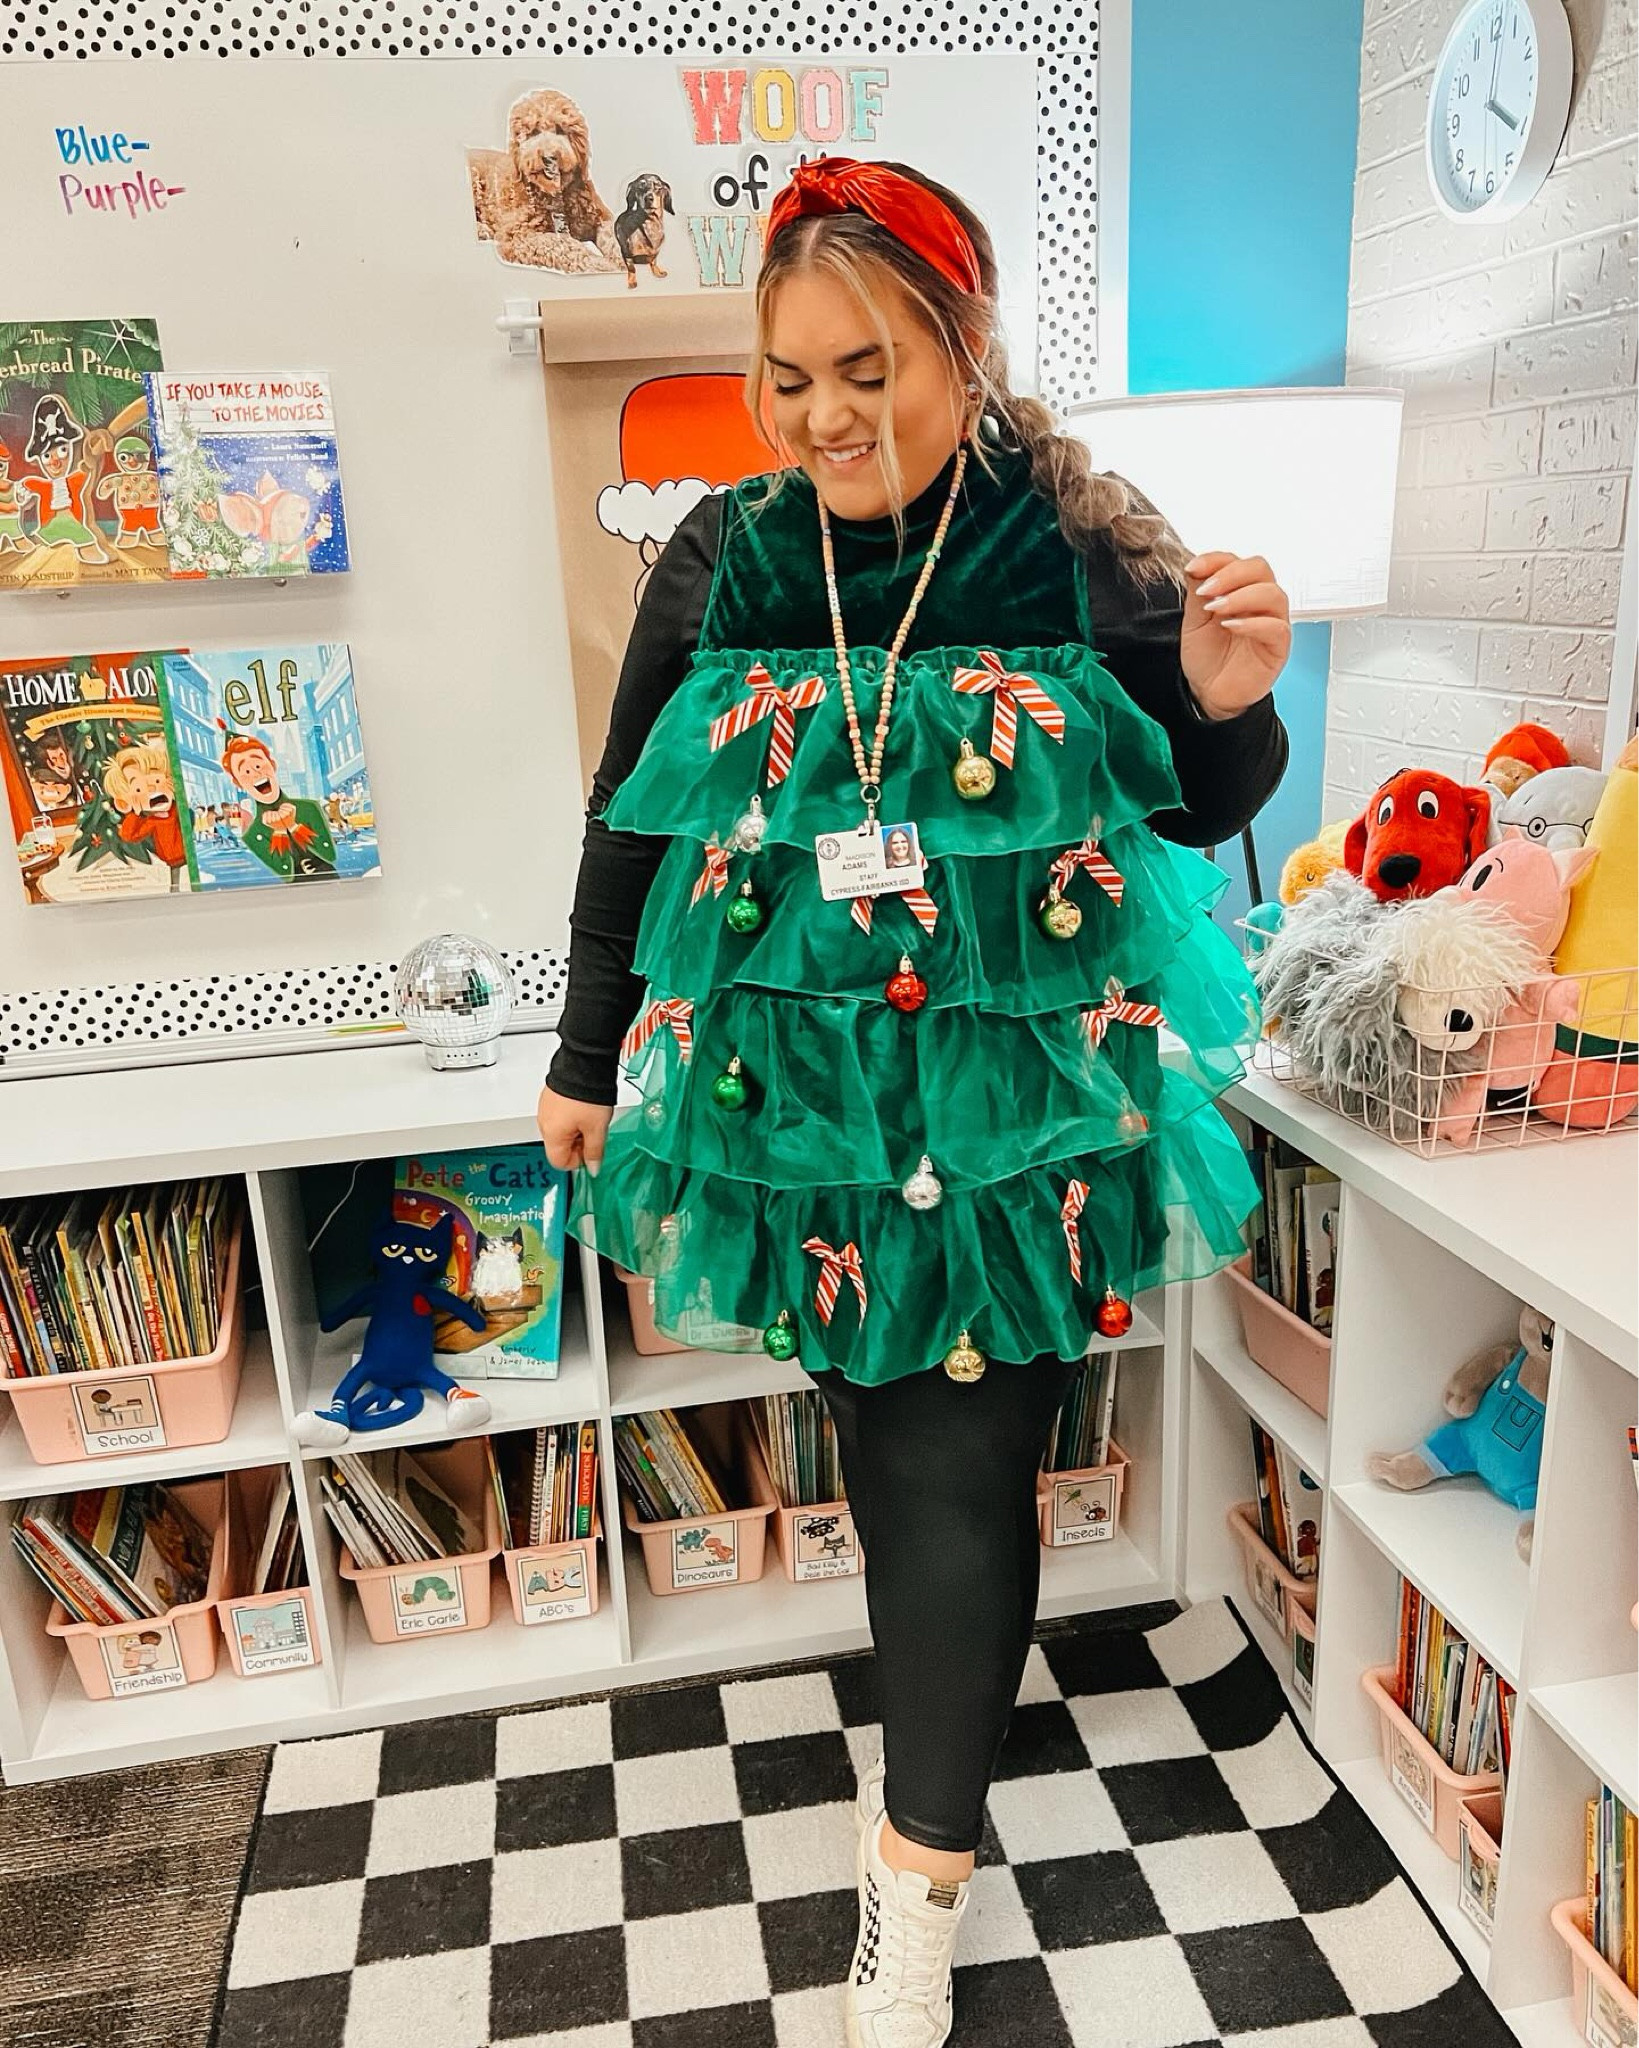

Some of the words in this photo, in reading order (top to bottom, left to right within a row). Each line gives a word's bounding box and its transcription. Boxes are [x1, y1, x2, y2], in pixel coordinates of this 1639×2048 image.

[1490, 16, 1502, 42] 12
[1473, 37, 1480, 62] 11
[1458, 73, 1470, 99] 10
[682, 67, 889, 145] WOOF
[1451, 114, 1461, 138] 9
[1455, 149, 1464, 172] 8
[714, 154, 769, 208] of
[1468, 170, 1477, 193] 7
[1485, 171, 1495, 194] 6
[31, 329, 55, 345] The
[0, 347, 75, 379] erbread
[81, 347, 143, 383] Pirate
[166, 383, 181, 401] IF
[185, 383, 214, 401] YOU
[218, 382, 254, 399] TAKE
[258, 383, 267, 399] A
[271, 381, 324, 399] MOUSE
[212, 407, 231, 422] TO
[234, 405, 264, 422] THE
[266, 403, 325, 422] MOVIES
[4, 672, 81, 708] HOME
[107, 666, 158, 699] ALON
[224, 659, 299, 727] elf
[842, 861, 868, 871] ADAMS
[859, 873, 878, 882] STAFF
[406, 1158, 465, 1188] Pete
[468, 1163, 487, 1175] the
[489, 1160, 551, 1189] Cat's
[479, 1205, 552, 1227] Imaginatio
[98, 1430, 154, 1448] School
[582, 1455, 591, 1504] SCHOLASTIC
[580, 1510, 589, 1532] FIRST
[1062, 1526, 1106, 1543] Insects
[677, 1568, 734, 1583] Dinosaurs
[401, 1617, 424, 1631] Eric
[427, 1612, 461, 1626] Carle
[539, 1603, 575, 1618] ABC's
[245, 1652, 309, 1670] Community
[114, 1670, 183, 1692] Friendship
